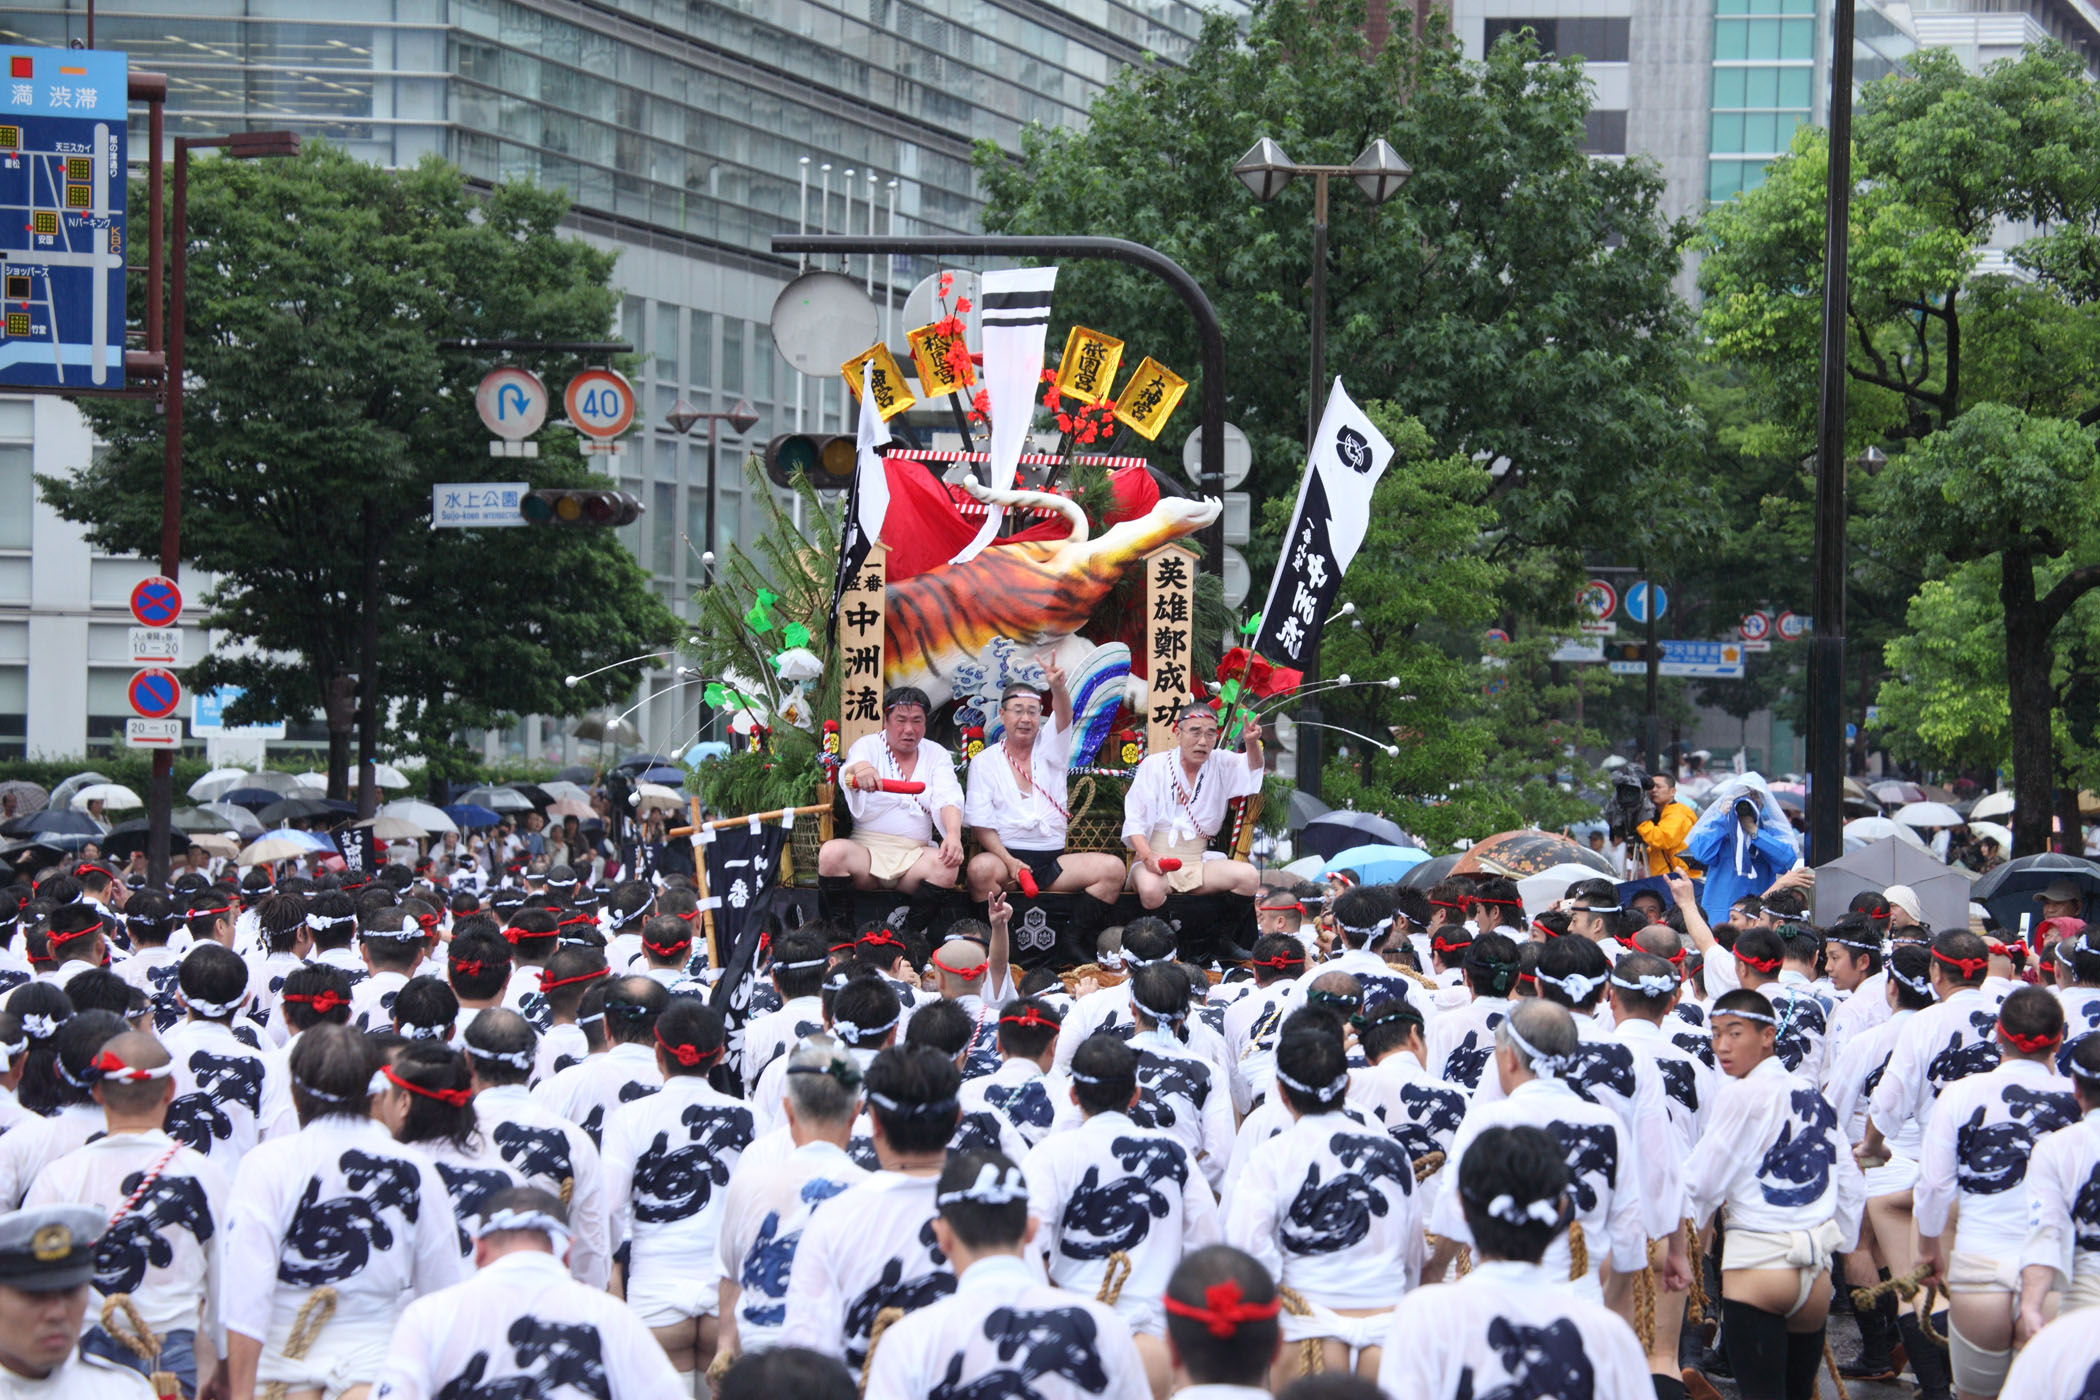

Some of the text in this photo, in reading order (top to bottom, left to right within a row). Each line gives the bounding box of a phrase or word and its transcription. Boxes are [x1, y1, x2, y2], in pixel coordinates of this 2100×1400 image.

[11, 84, 33, 106] 満
[49, 86, 97, 109] 渋滞
[110, 226, 121, 254] KBC
[583, 389, 619, 418] 40
[1131, 374, 1166, 422] 大神宮
[444, 490, 518, 508] 水上公園
[863, 562, 884, 593] 一番
[1152, 557, 1189, 728] 英雄鄭成功
[845, 601, 881, 722] 中洲流
[724, 859, 750, 909] 一番
